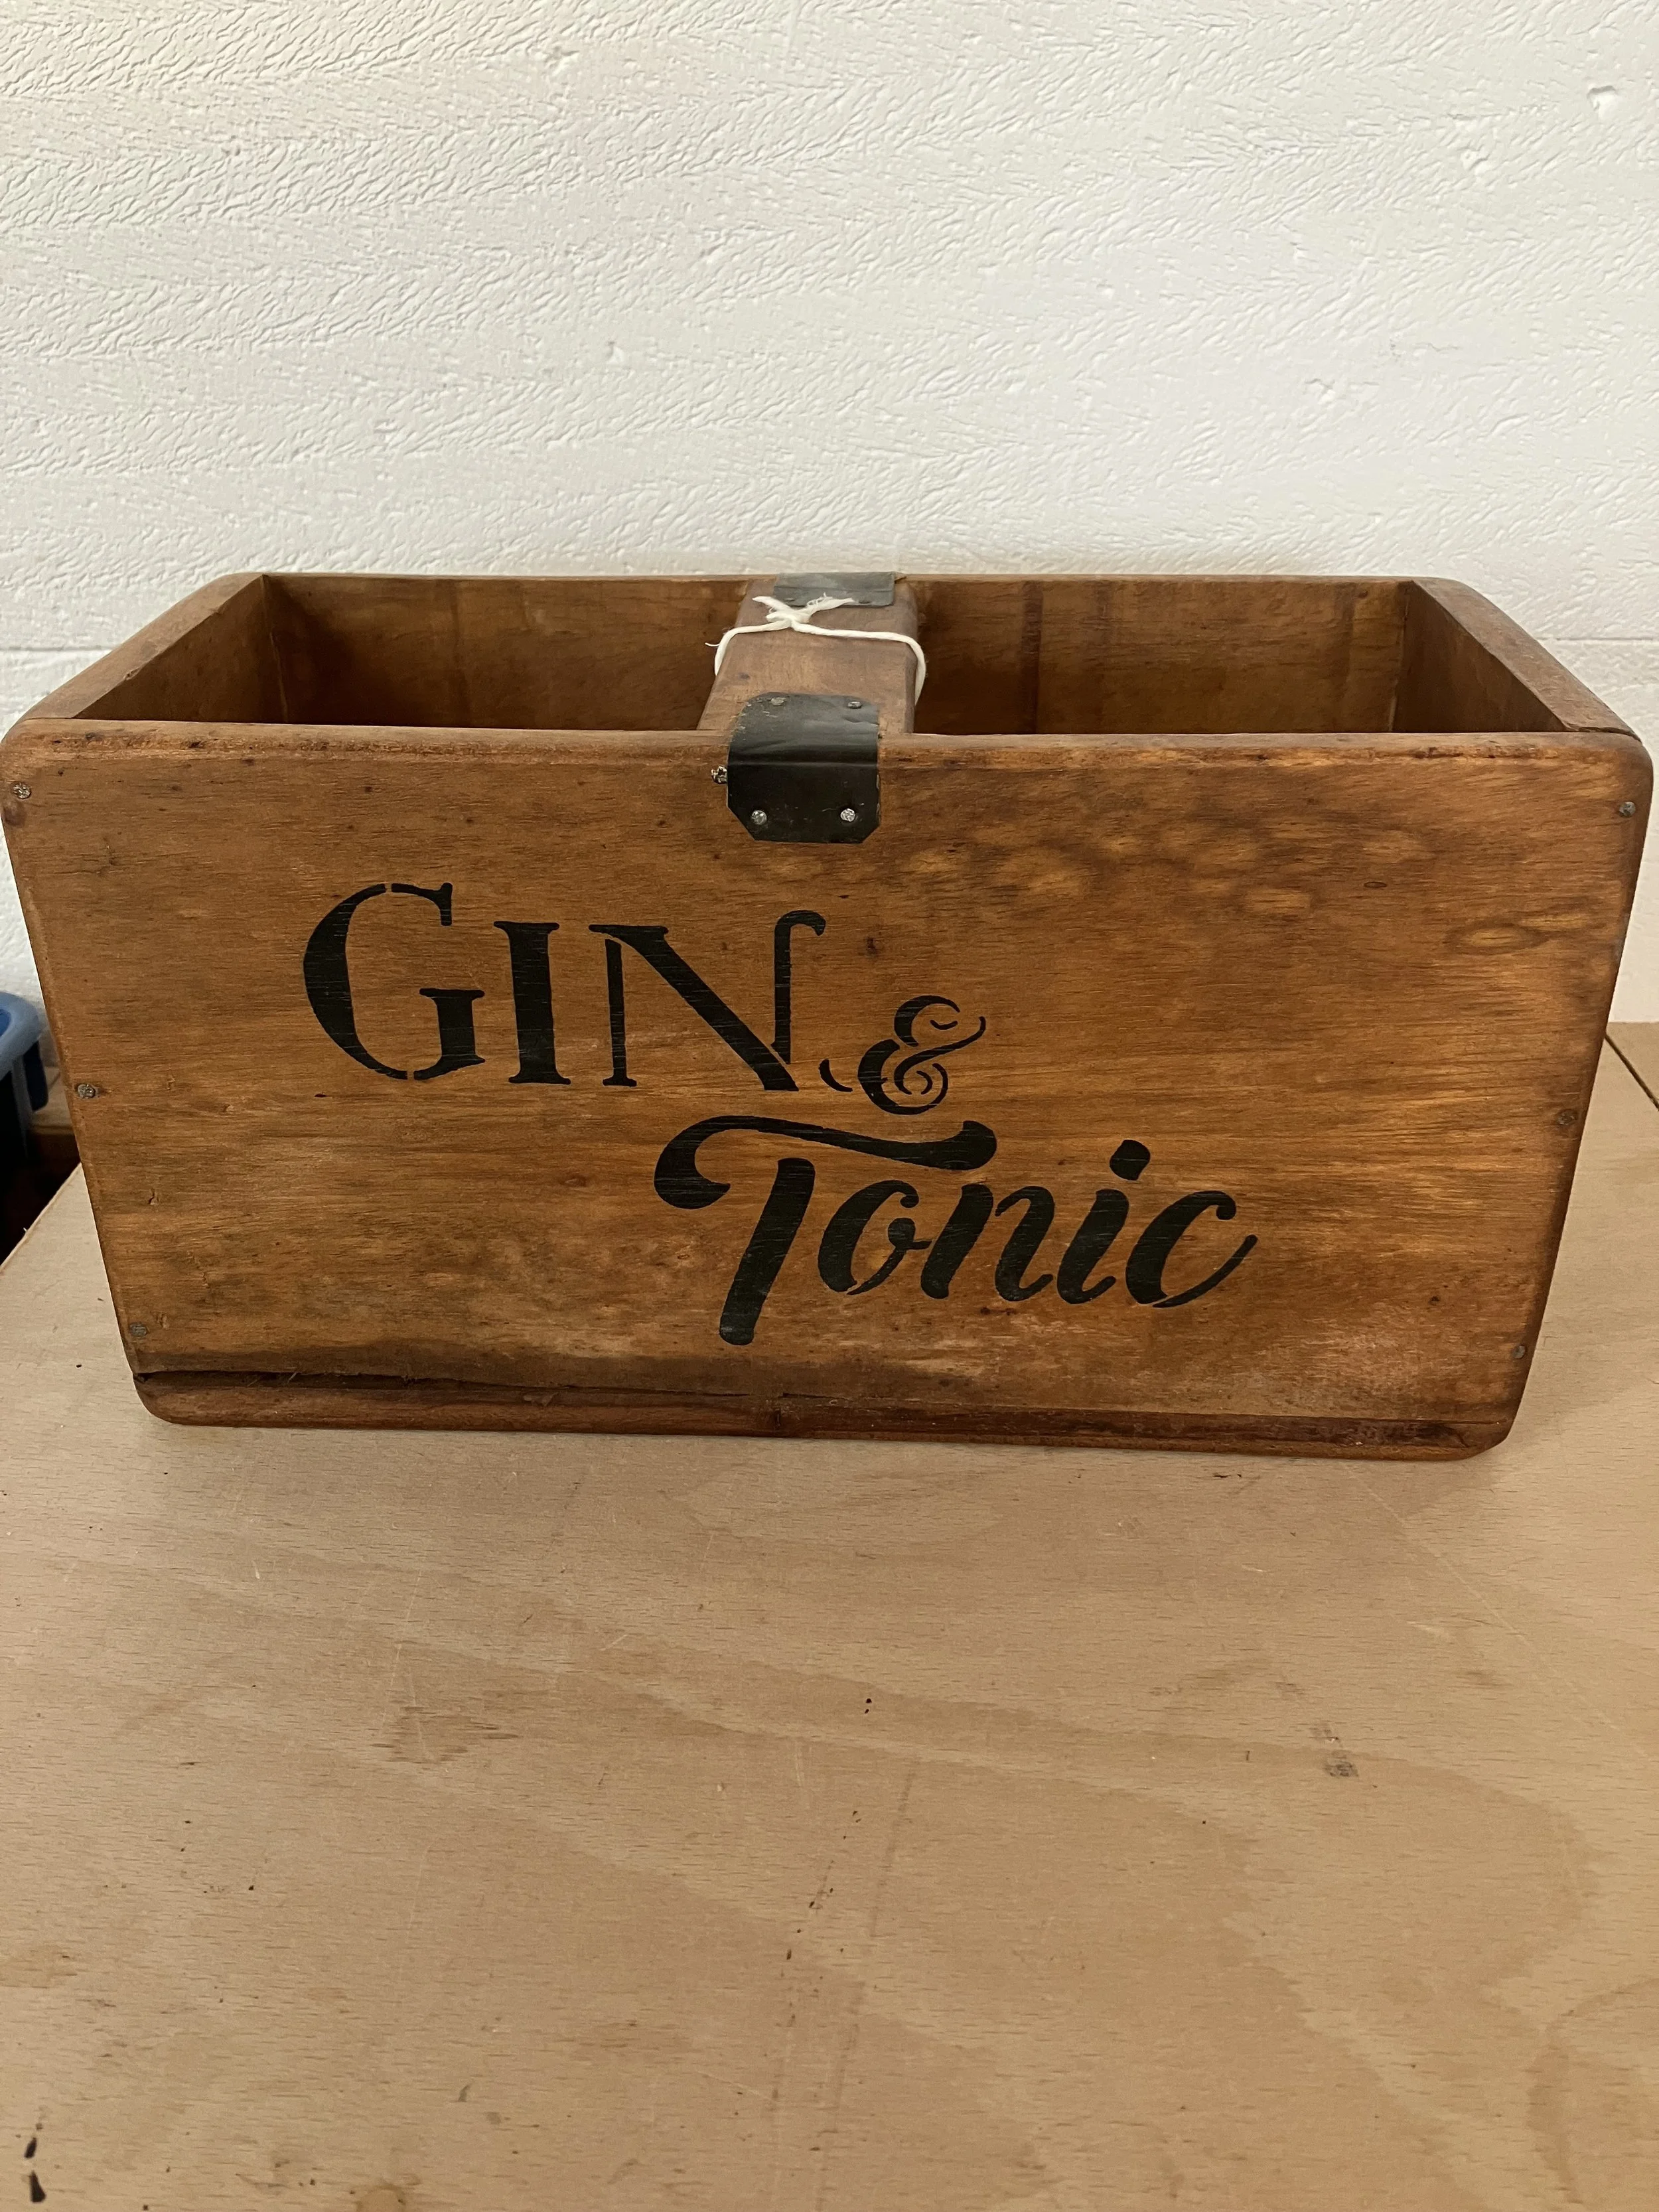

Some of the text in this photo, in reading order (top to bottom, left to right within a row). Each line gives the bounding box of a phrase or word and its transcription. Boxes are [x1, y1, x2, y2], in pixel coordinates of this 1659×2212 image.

[303, 882, 987, 1116] GIN &
[654, 1115, 1258, 1346] Tonic
